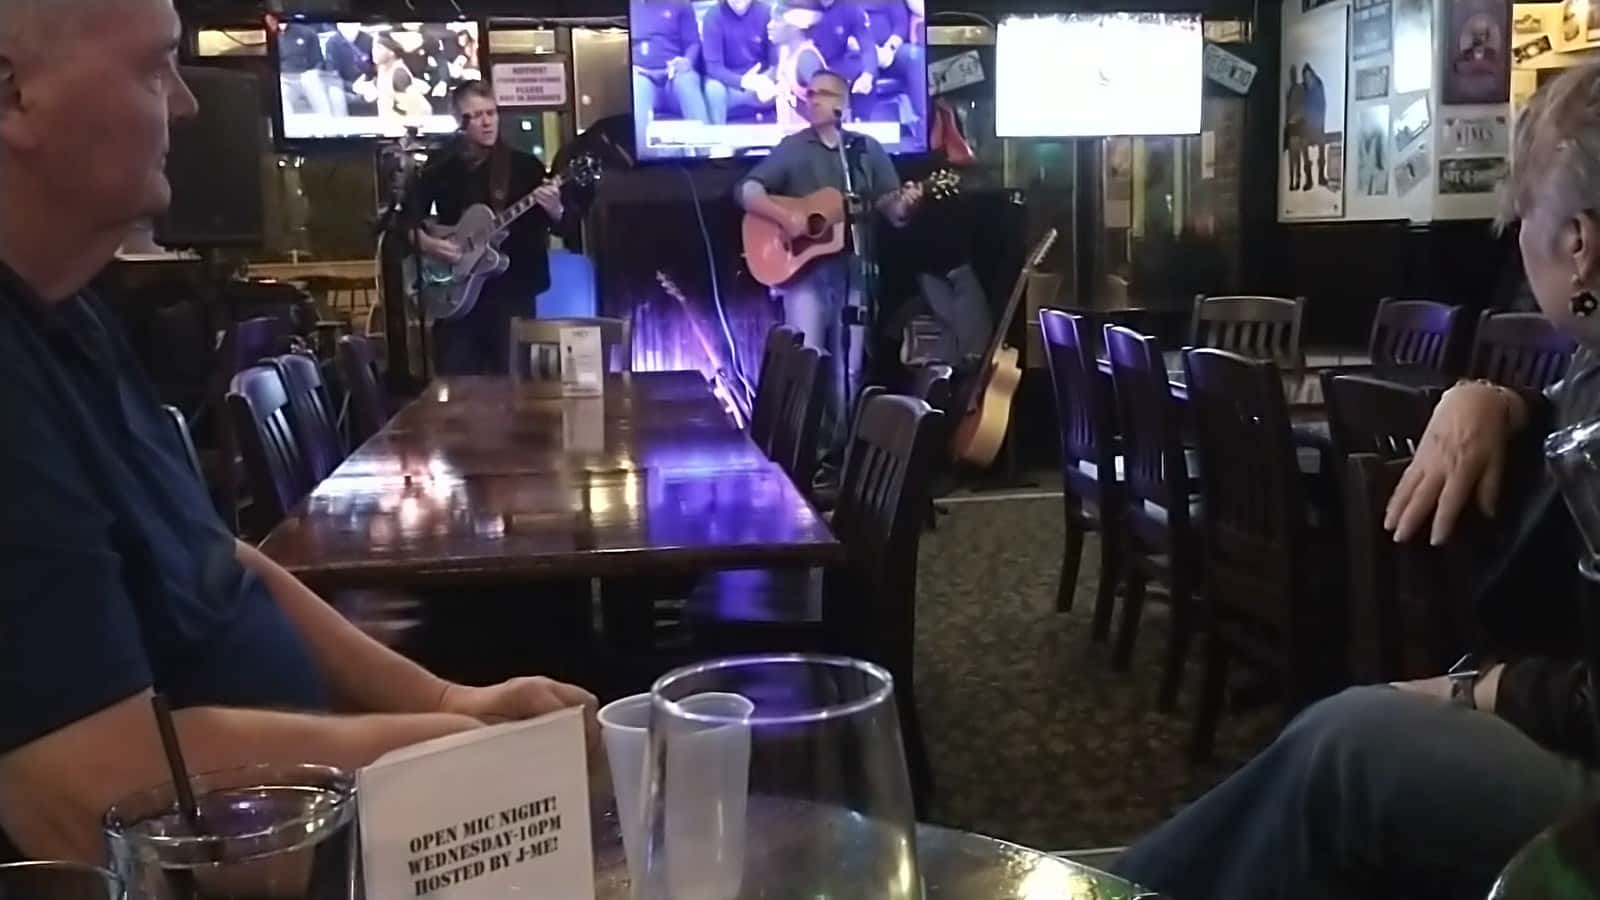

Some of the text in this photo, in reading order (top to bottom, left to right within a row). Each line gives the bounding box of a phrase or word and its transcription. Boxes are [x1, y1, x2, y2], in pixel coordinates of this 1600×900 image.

[408, 815, 561, 876] WEDNESDAY-10PM
[409, 795, 557, 853] OPEN MIC NIGHT!
[414, 836, 559, 896] HOSTED BY J-ME!
